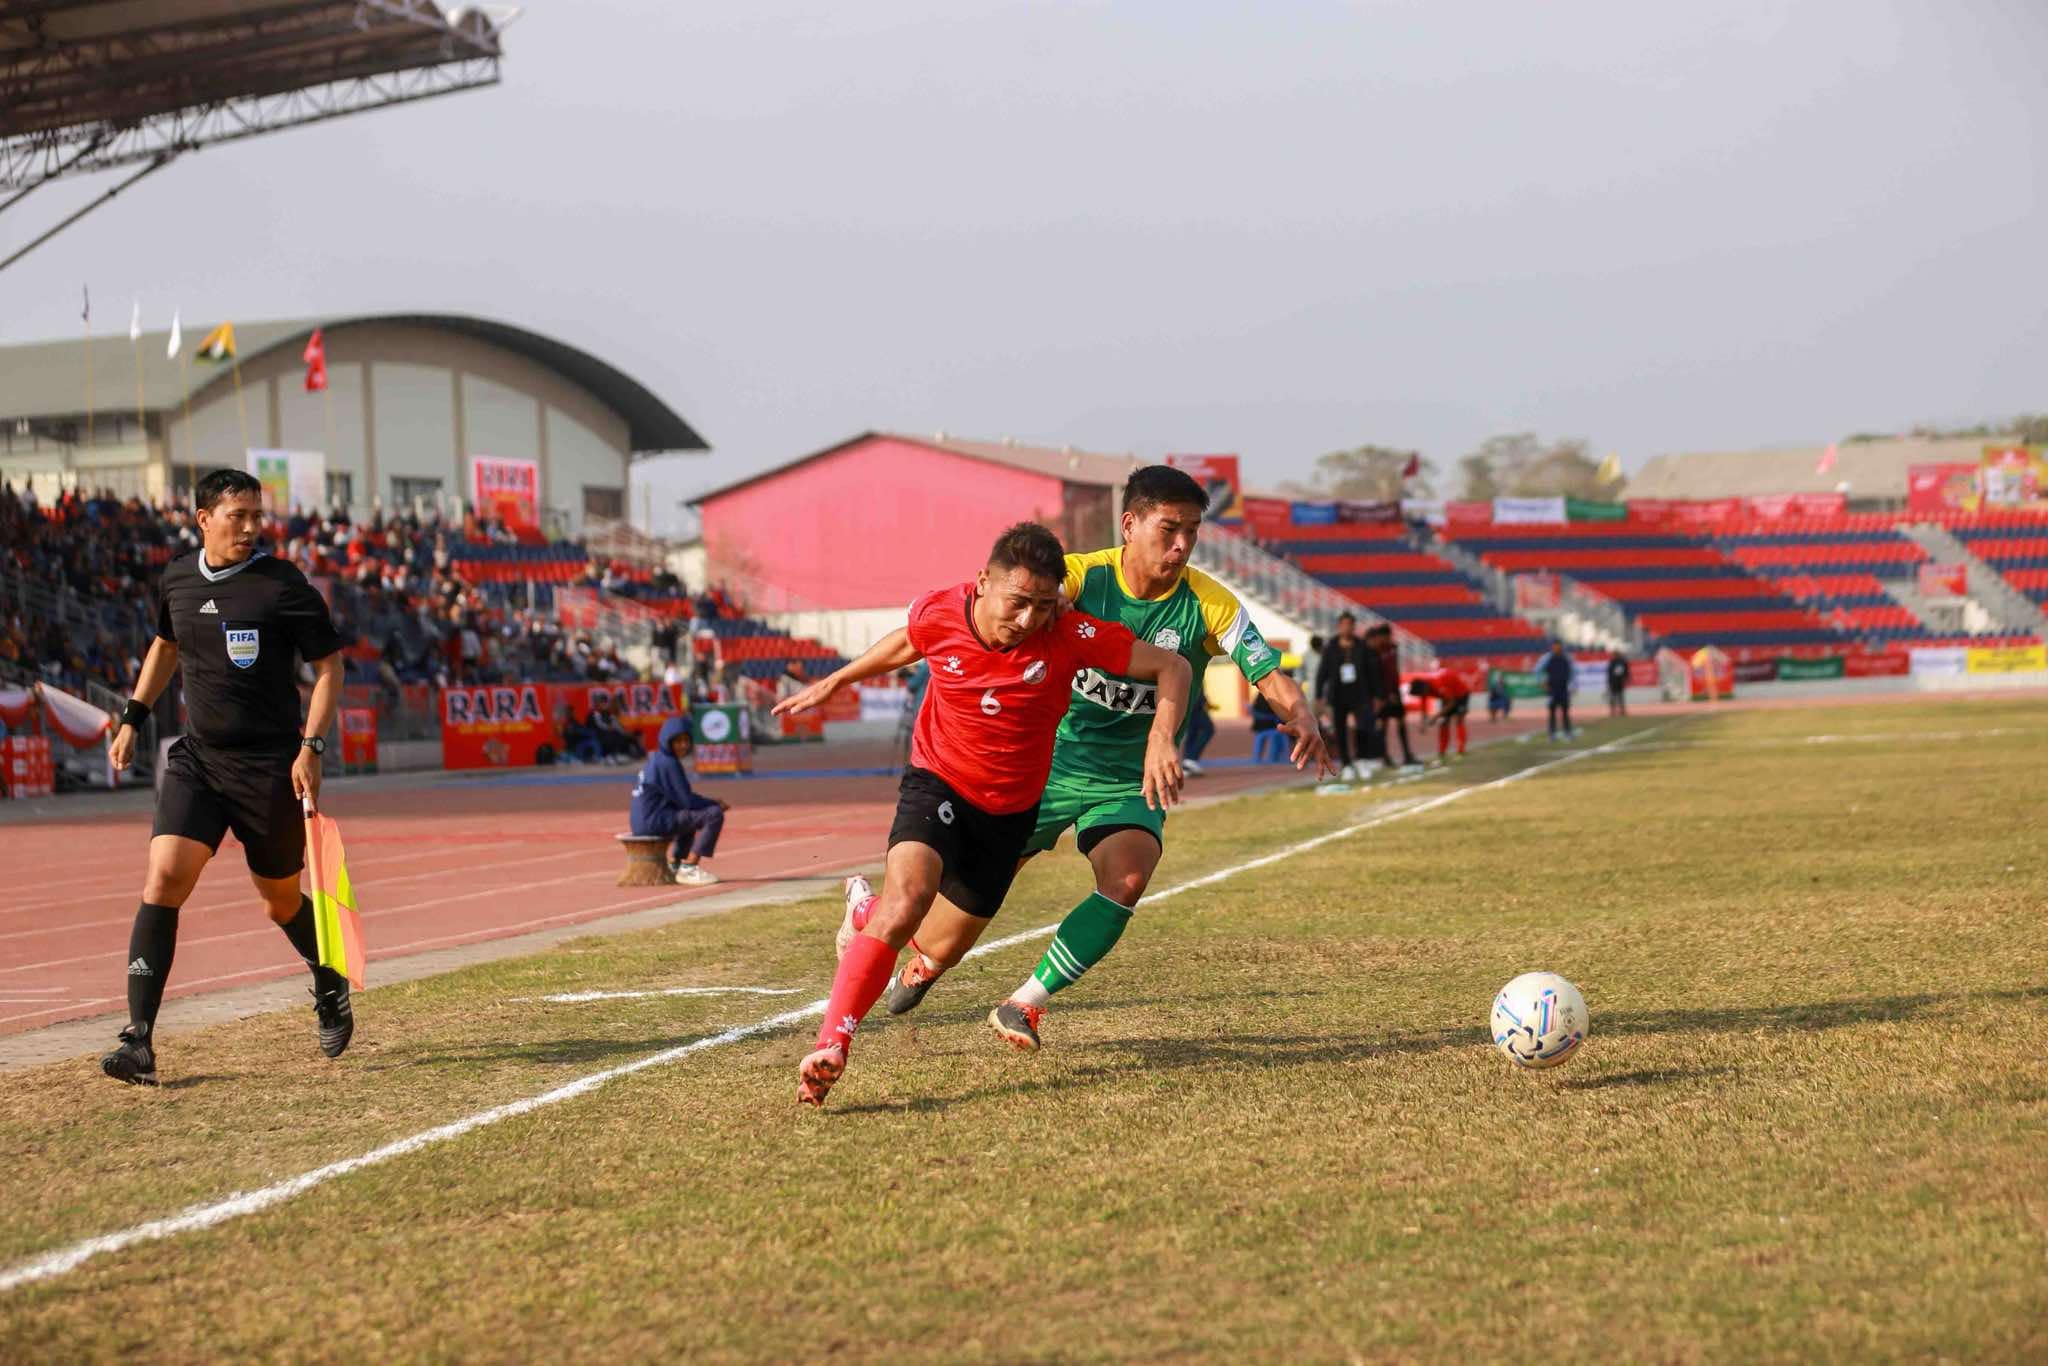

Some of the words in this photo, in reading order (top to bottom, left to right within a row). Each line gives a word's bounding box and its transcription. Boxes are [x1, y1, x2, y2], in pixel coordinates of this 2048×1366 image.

[229, 632, 256, 642] FIFA
[446, 687, 544, 724] RARA
[981, 688, 1001, 716] 6
[938, 801, 955, 824] 6
